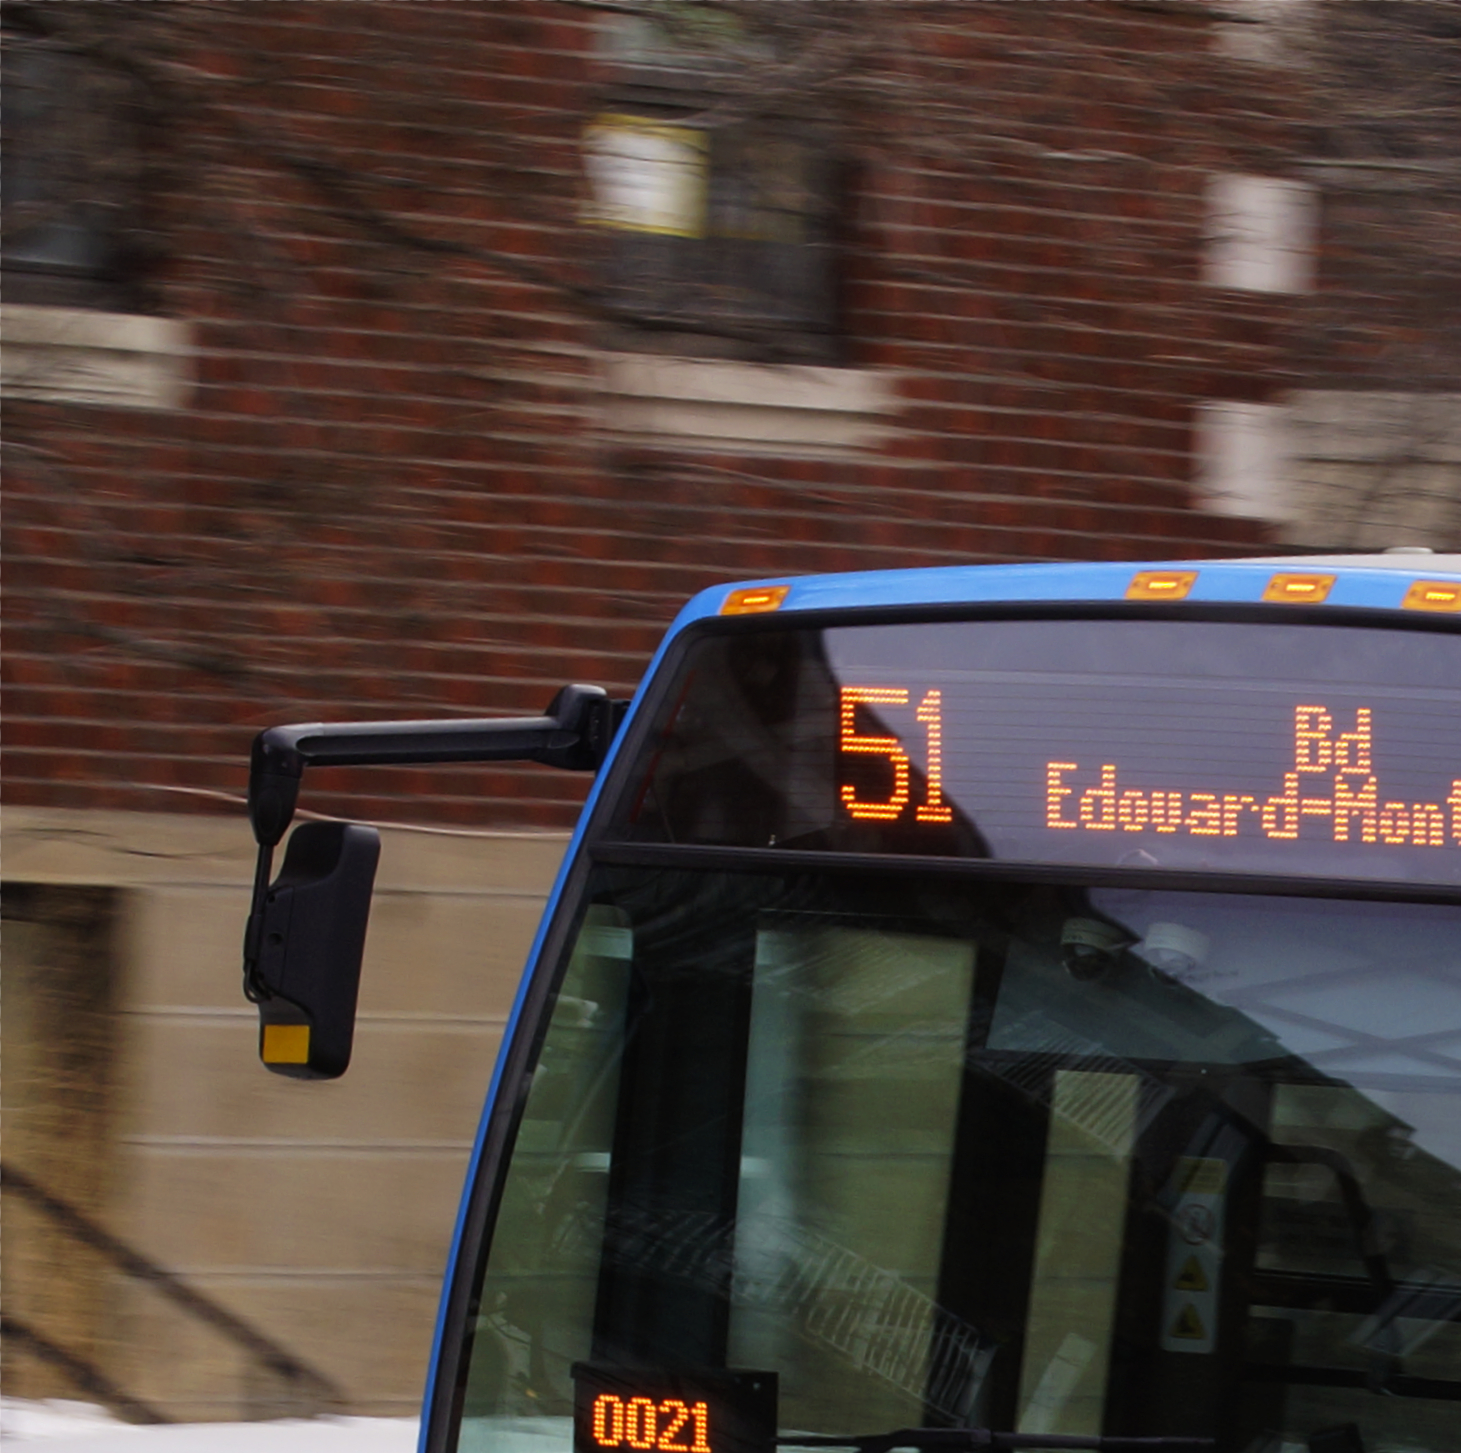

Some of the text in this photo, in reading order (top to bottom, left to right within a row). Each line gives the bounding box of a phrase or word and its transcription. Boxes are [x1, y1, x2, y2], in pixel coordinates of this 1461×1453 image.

[840, 686, 953, 824] 51
[1296, 705, 1371, 775] Bd
[593, 1393, 712, 1453] 0021
